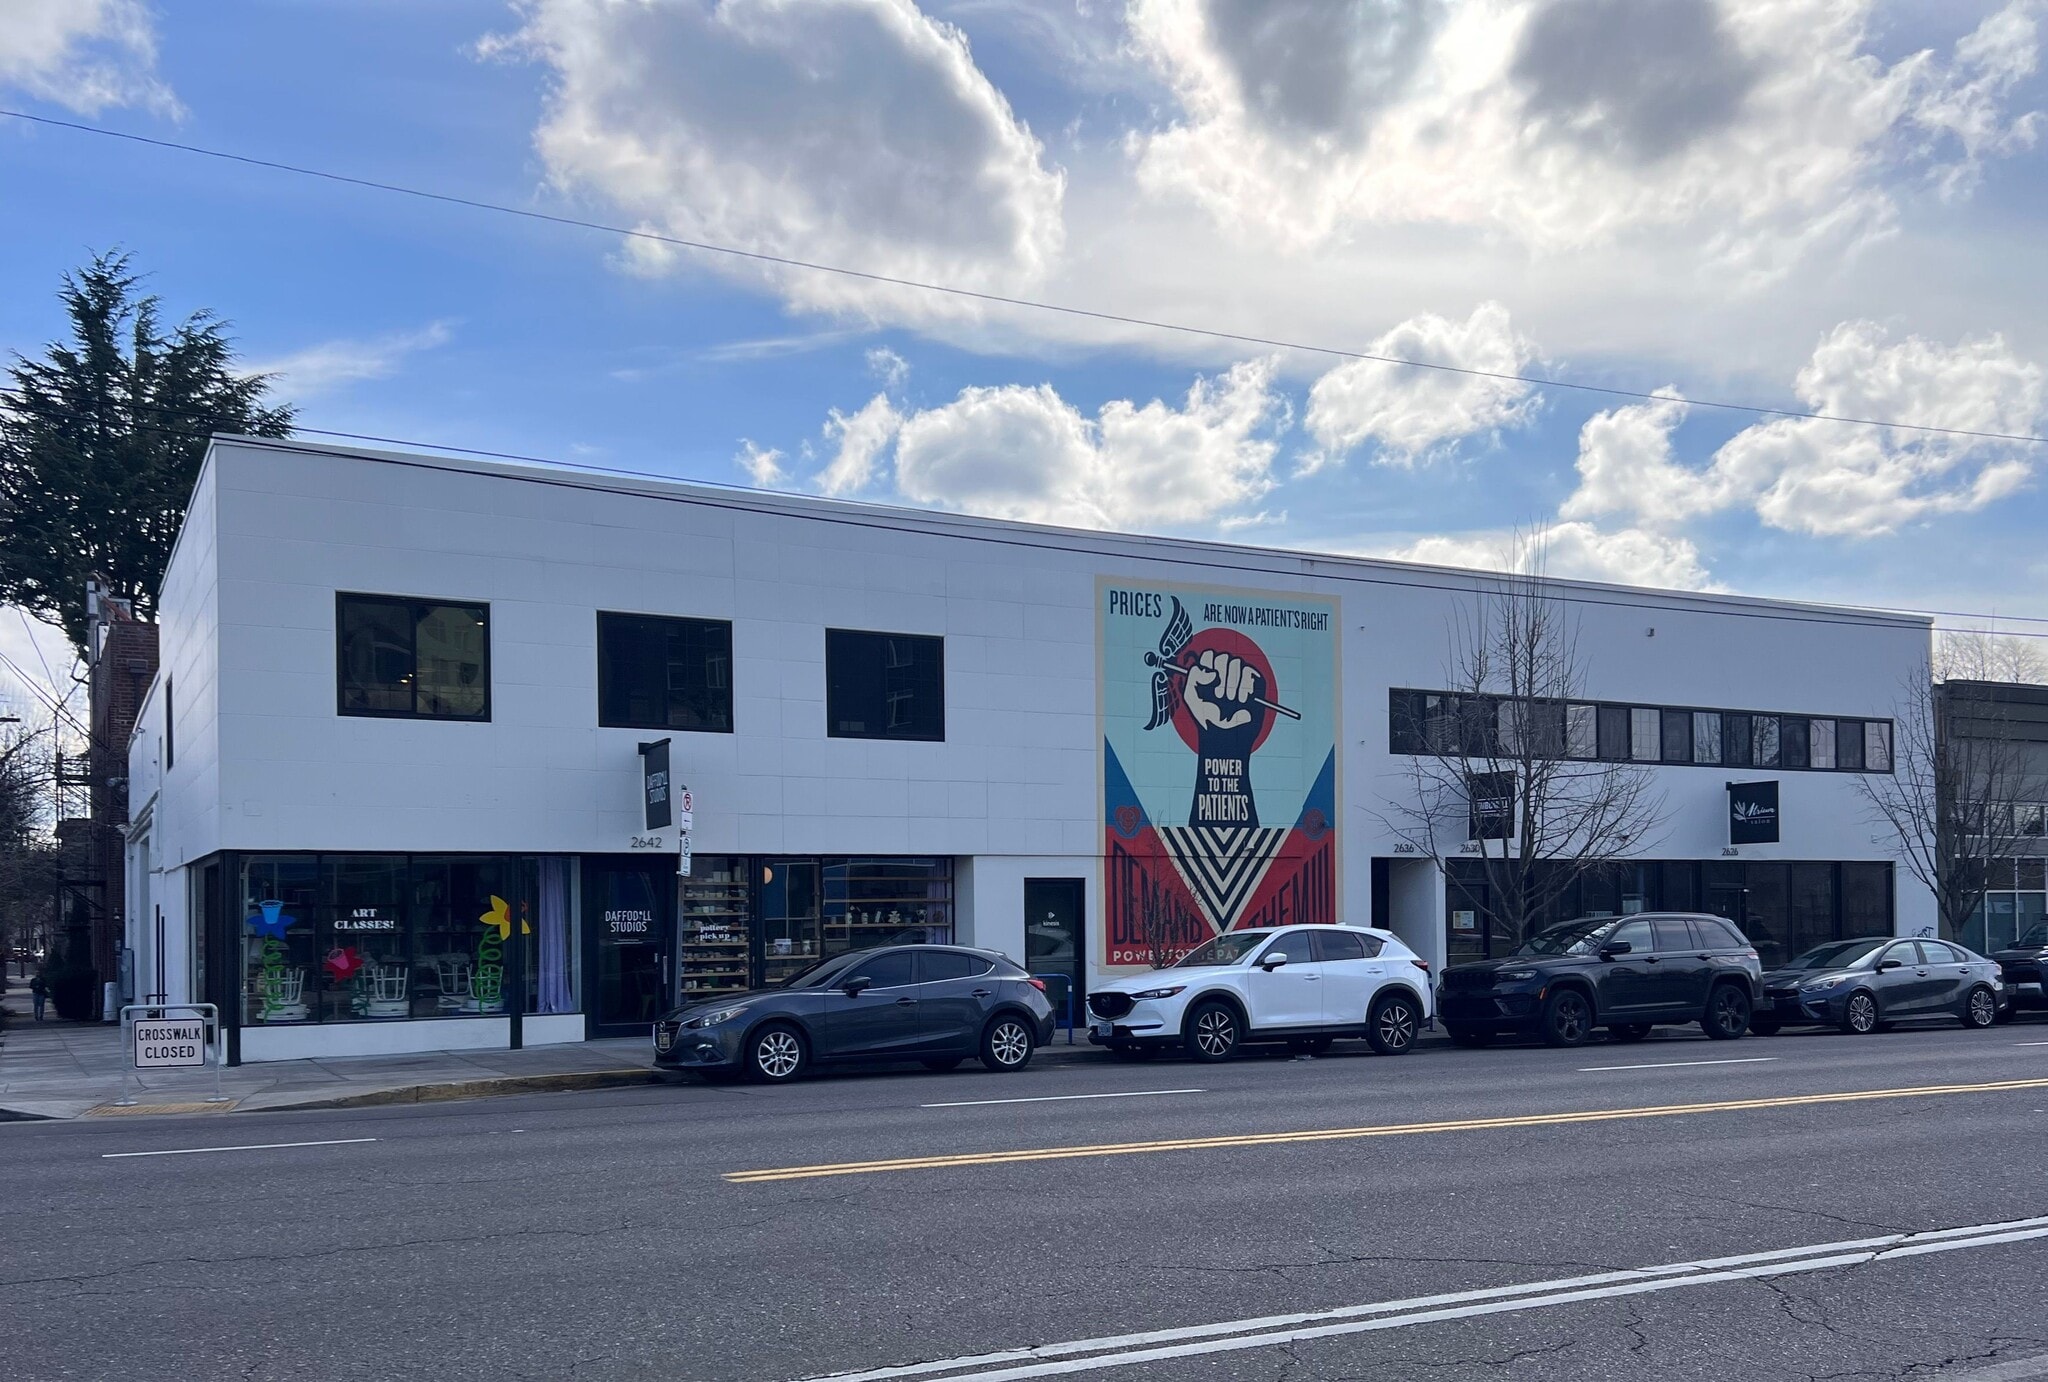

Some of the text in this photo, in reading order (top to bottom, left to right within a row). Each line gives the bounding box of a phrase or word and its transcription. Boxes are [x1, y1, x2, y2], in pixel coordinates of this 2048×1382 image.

[1110, 591, 1328, 631] PRICES ARE NOW A PATIENT'S RIGHT
[1205, 758, 1242, 776] POWER
[1208, 778, 1239, 792] TO THE
[1198, 794, 1249, 821] PATIENTS
[631, 836, 662, 848] 2642
[1394, 843, 1415, 853] 2636
[1722, 848, 1738, 856] 2626
[1113, 840, 1203, 945] DEMAND
[350, 908, 377, 918] ART
[334, 920, 395, 930] CLASSES!
[610, 921, 647, 932] STUDIOS
[700, 925, 730, 933] pottery
[700, 933, 717, 941] pick
[138, 1027, 201, 1041] CROSSWALK
[145, 1046, 195, 1058] CLOSED
